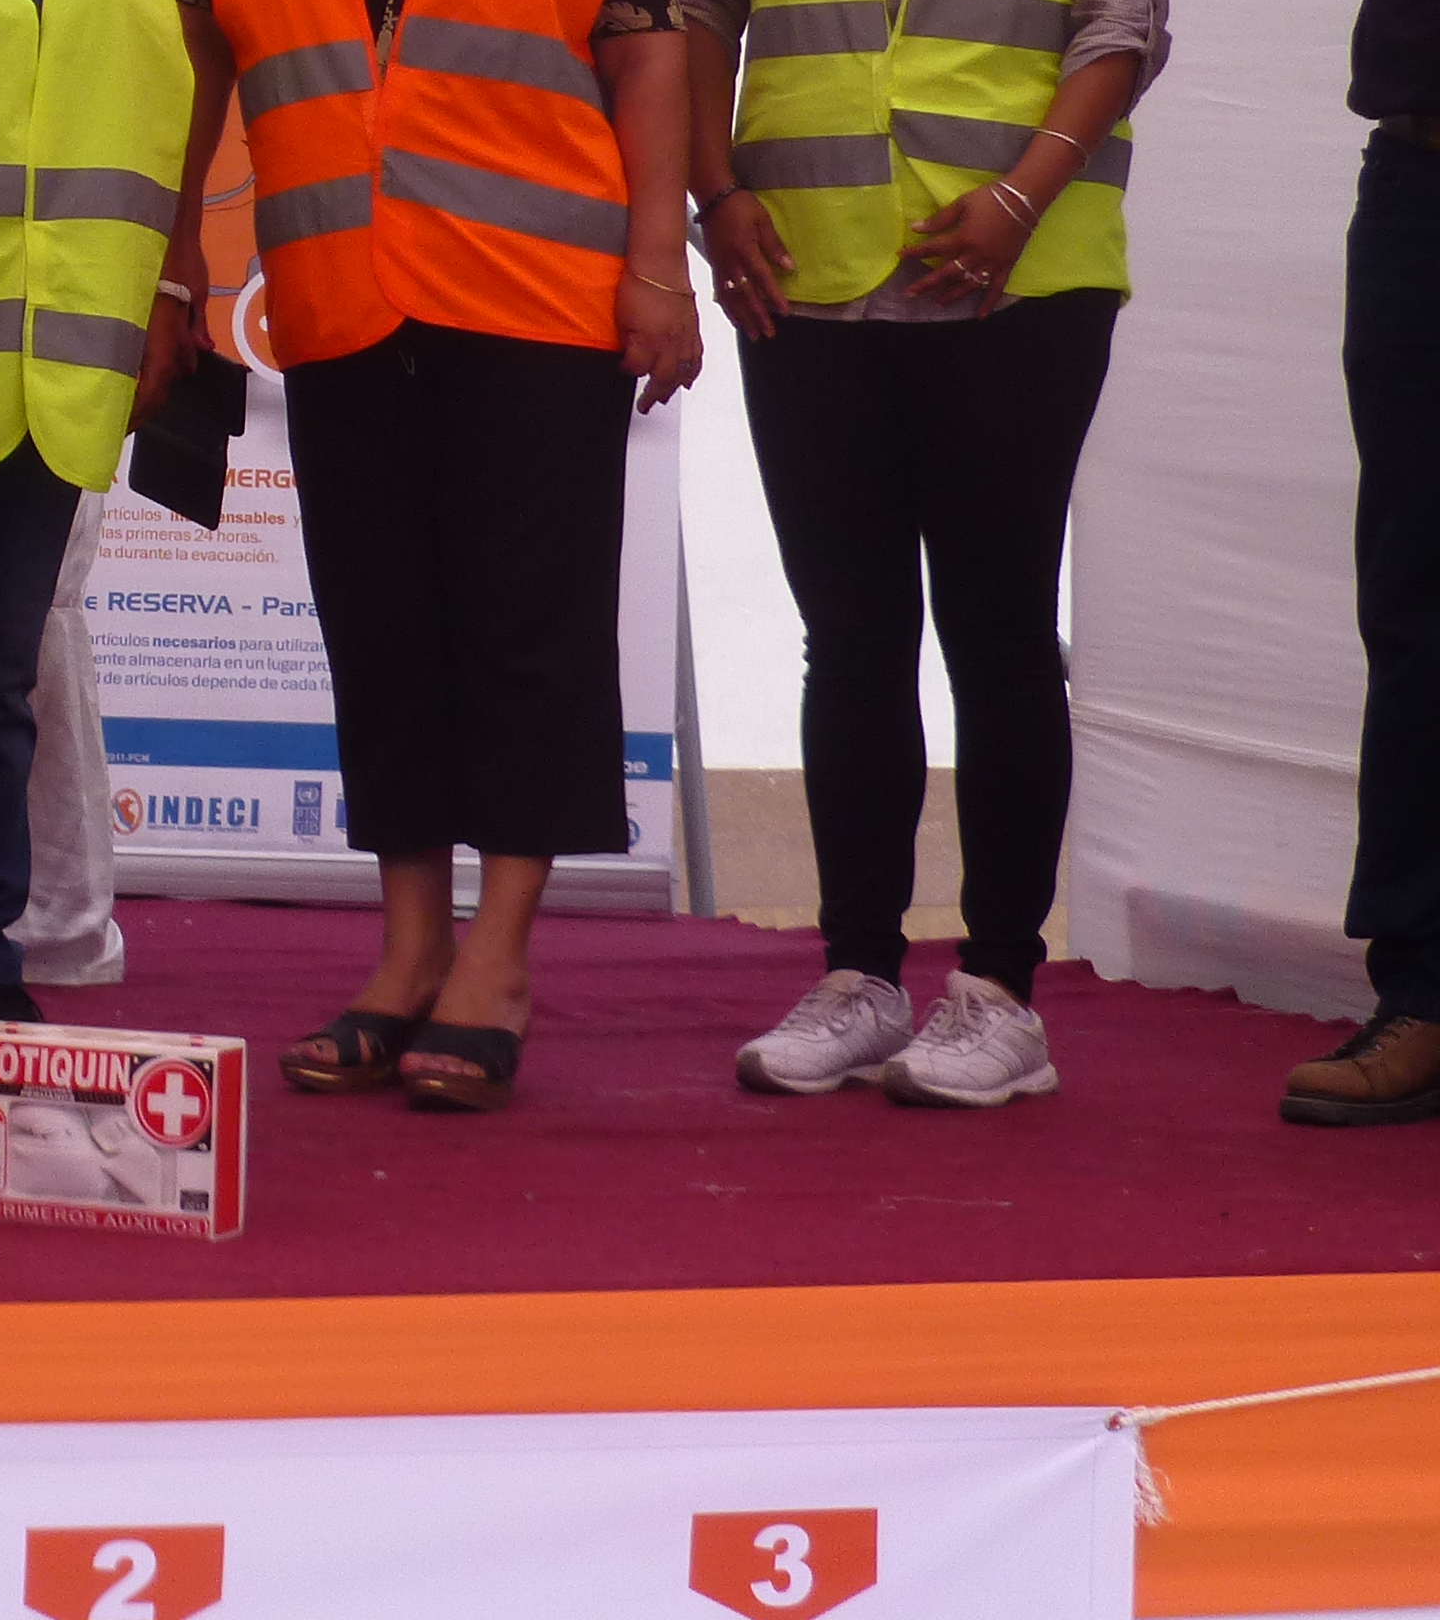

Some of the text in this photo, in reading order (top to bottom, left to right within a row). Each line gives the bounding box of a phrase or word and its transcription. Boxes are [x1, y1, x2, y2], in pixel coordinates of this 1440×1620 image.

[125, 527, 192, 543] primeras
[194, 529, 214, 543] 24
[114, 545, 173, 560] durante
[175, 547, 189, 561] la
[193, 548, 278, 564] evacuación.
[107, 591, 234, 616] RESERVA
[152, 636, 237, 650] necesarios
[238, 638, 273, 653] para
[128, 654, 221, 669] almacenarla
[223, 658, 243, 670] en
[245, 659, 265, 670] un
[267, 657, 305, 674] lugar
[103, 671, 122, 685] de
[124, 671, 189, 687] artículos
[191, 674, 258, 690] depende
[259, 675, 278, 689] de
[280, 677, 317, 691] cada
[147, 793, 260, 828] INDECI
[88, 1541, 157, 1620] 2
[751, 1525, 813, 1607] 3
